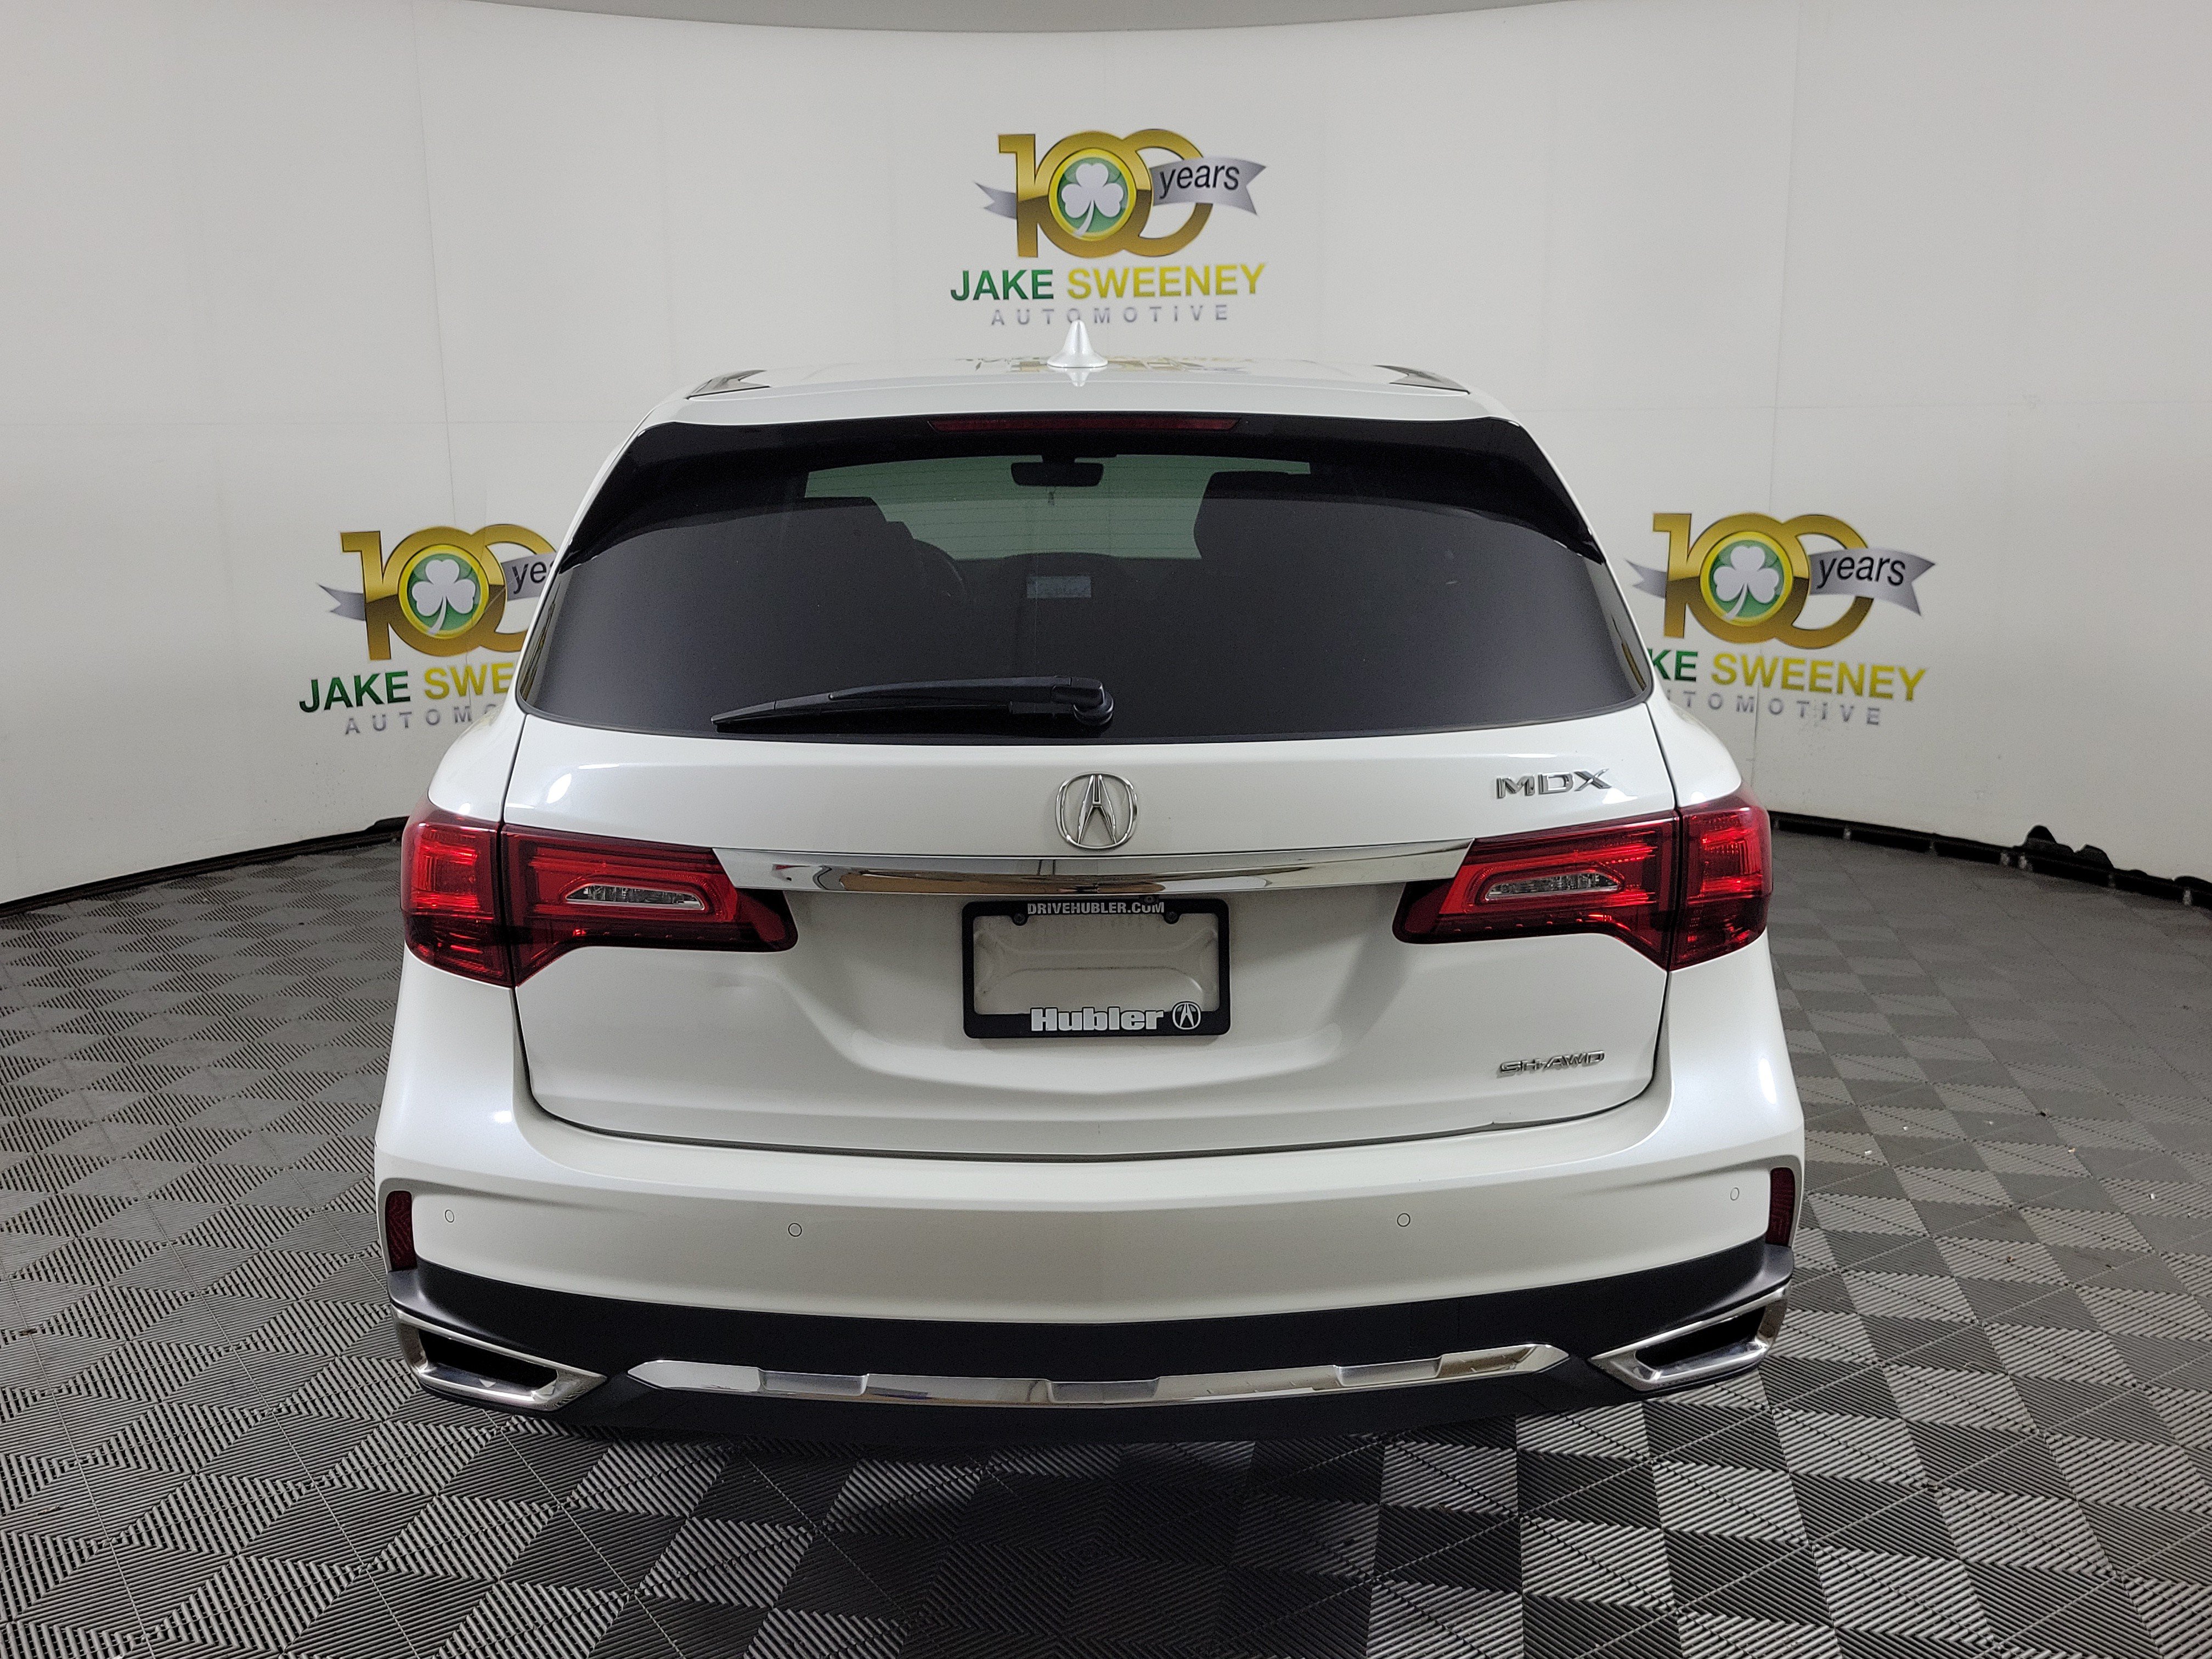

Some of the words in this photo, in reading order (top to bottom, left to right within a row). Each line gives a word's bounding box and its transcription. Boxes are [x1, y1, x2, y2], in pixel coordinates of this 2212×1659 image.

[997, 128, 1214, 258] 100
[1159, 164, 1240, 199] years
[950, 268, 1054, 301] JAKE
[1066, 263, 1266, 300] SWEENEY
[990, 304, 1228, 326] AUTOMOTIVE
[511, 560, 555, 595] ye
[1652, 512, 1875, 650] 100
[1816, 555, 1906, 589] years
[298, 670, 411, 713] JAKE
[1711, 651, 1927, 702] SWEENEY
[1666, 689, 1881, 725] TOMOTIVE
[1496, 768, 1612, 799] MDX
[1026, 901, 1165, 915] DRIVEHUBLER.COM
[1030, 1006, 1164, 1032] Hubler
[1500, 1049, 1605, 1074] SH-AWD
